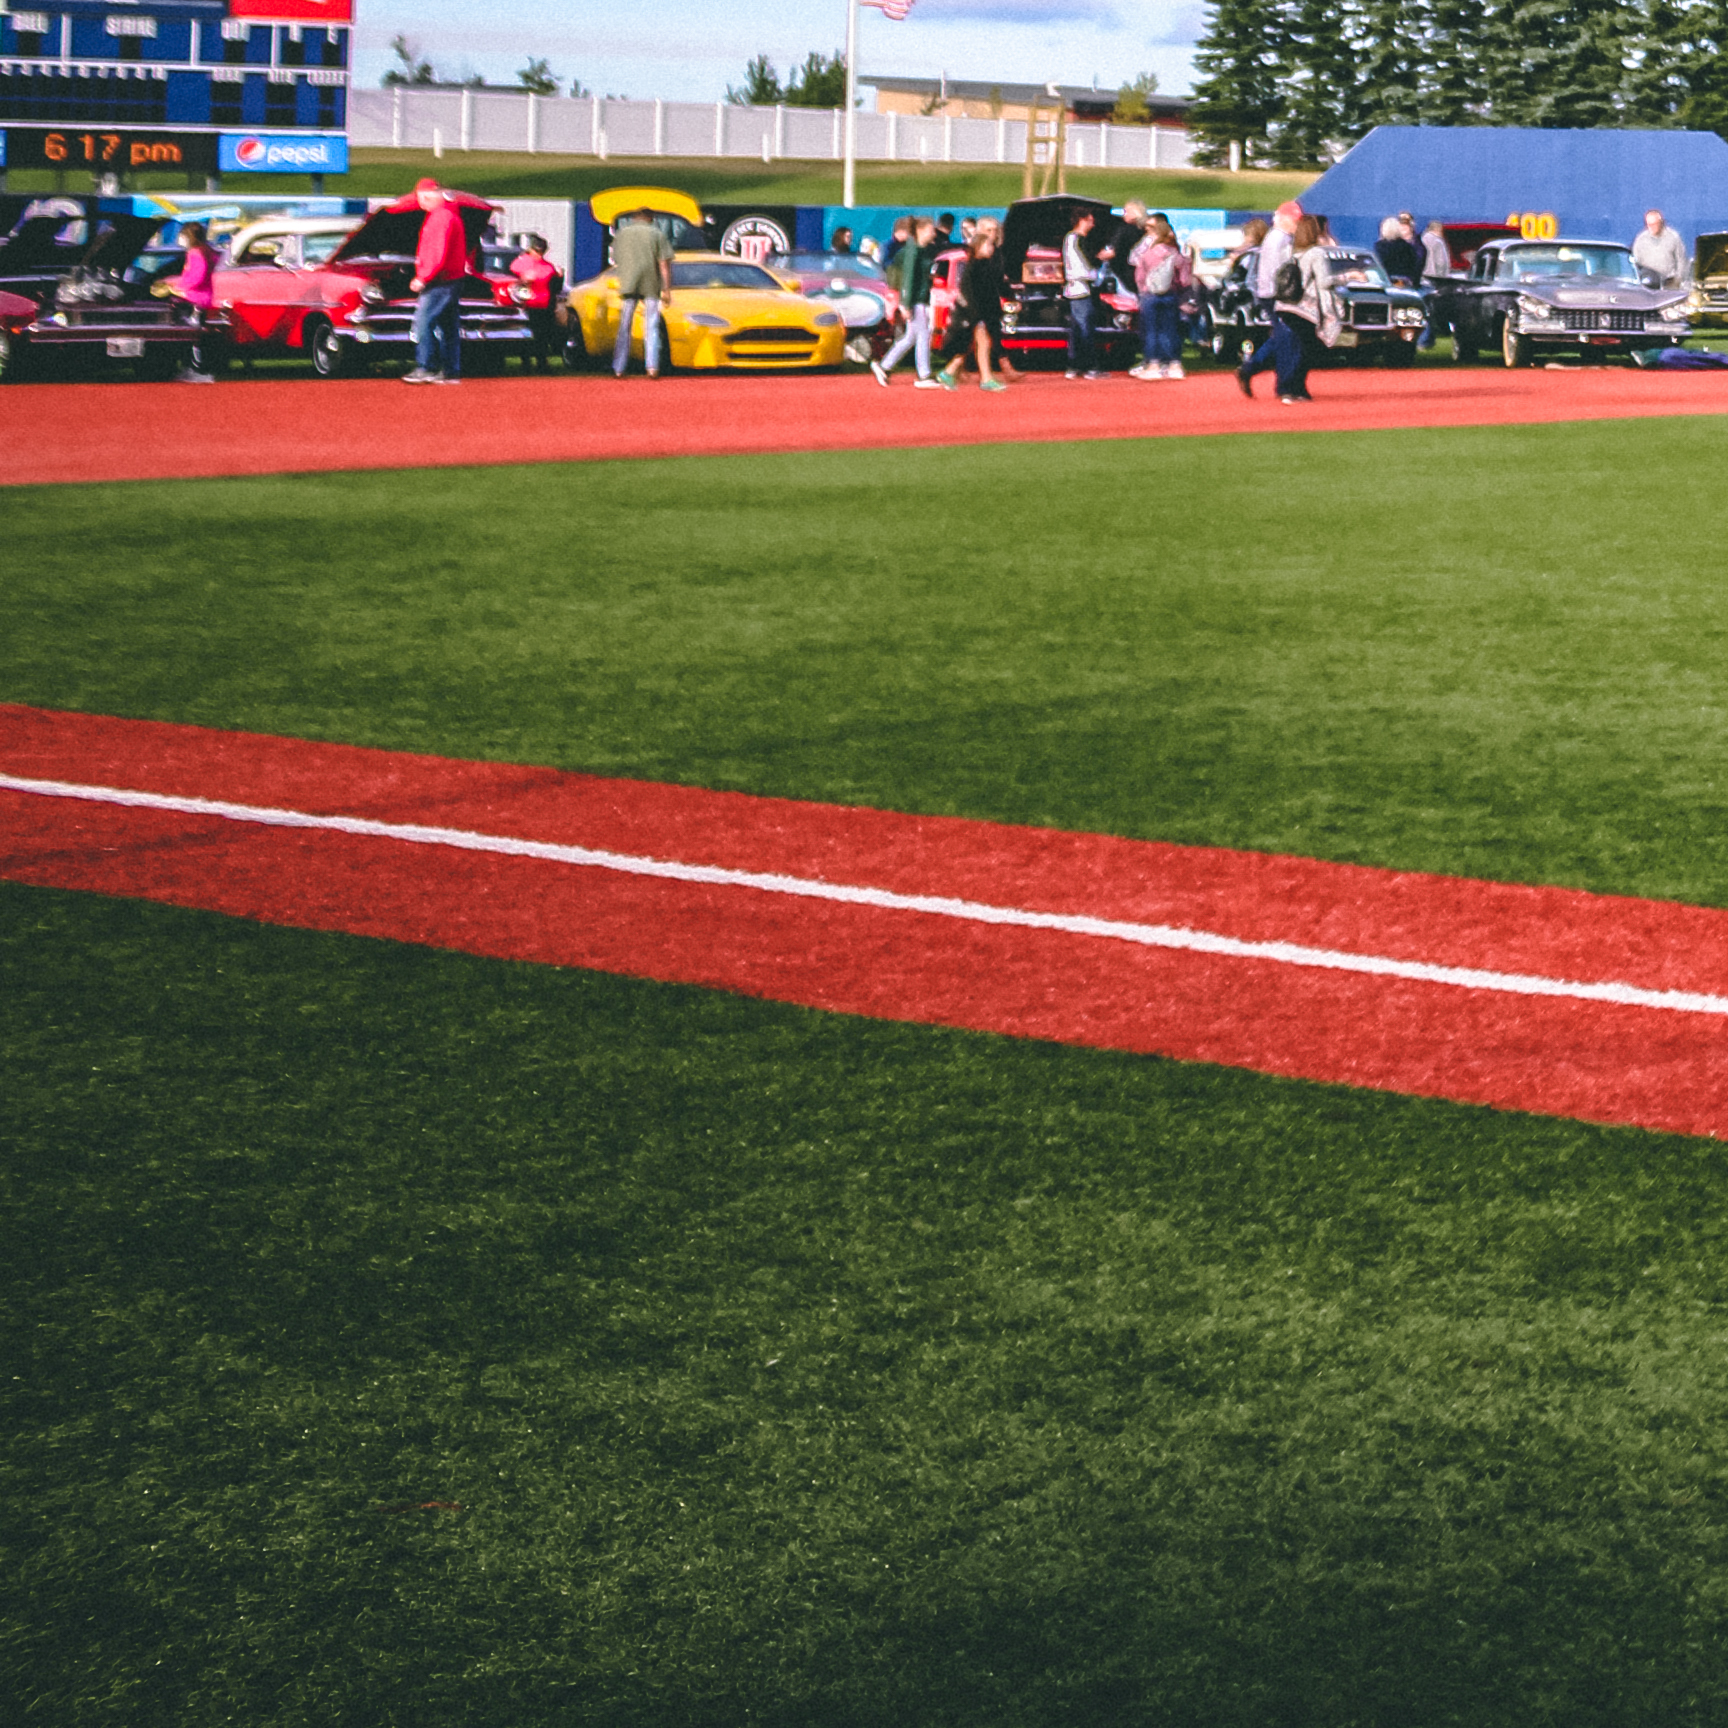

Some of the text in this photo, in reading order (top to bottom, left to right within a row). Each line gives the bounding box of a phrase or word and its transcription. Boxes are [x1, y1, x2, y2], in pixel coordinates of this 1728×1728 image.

[45, 133, 68, 161] 6
[130, 142, 182, 165] pm
[266, 143, 328, 164] pepsi
